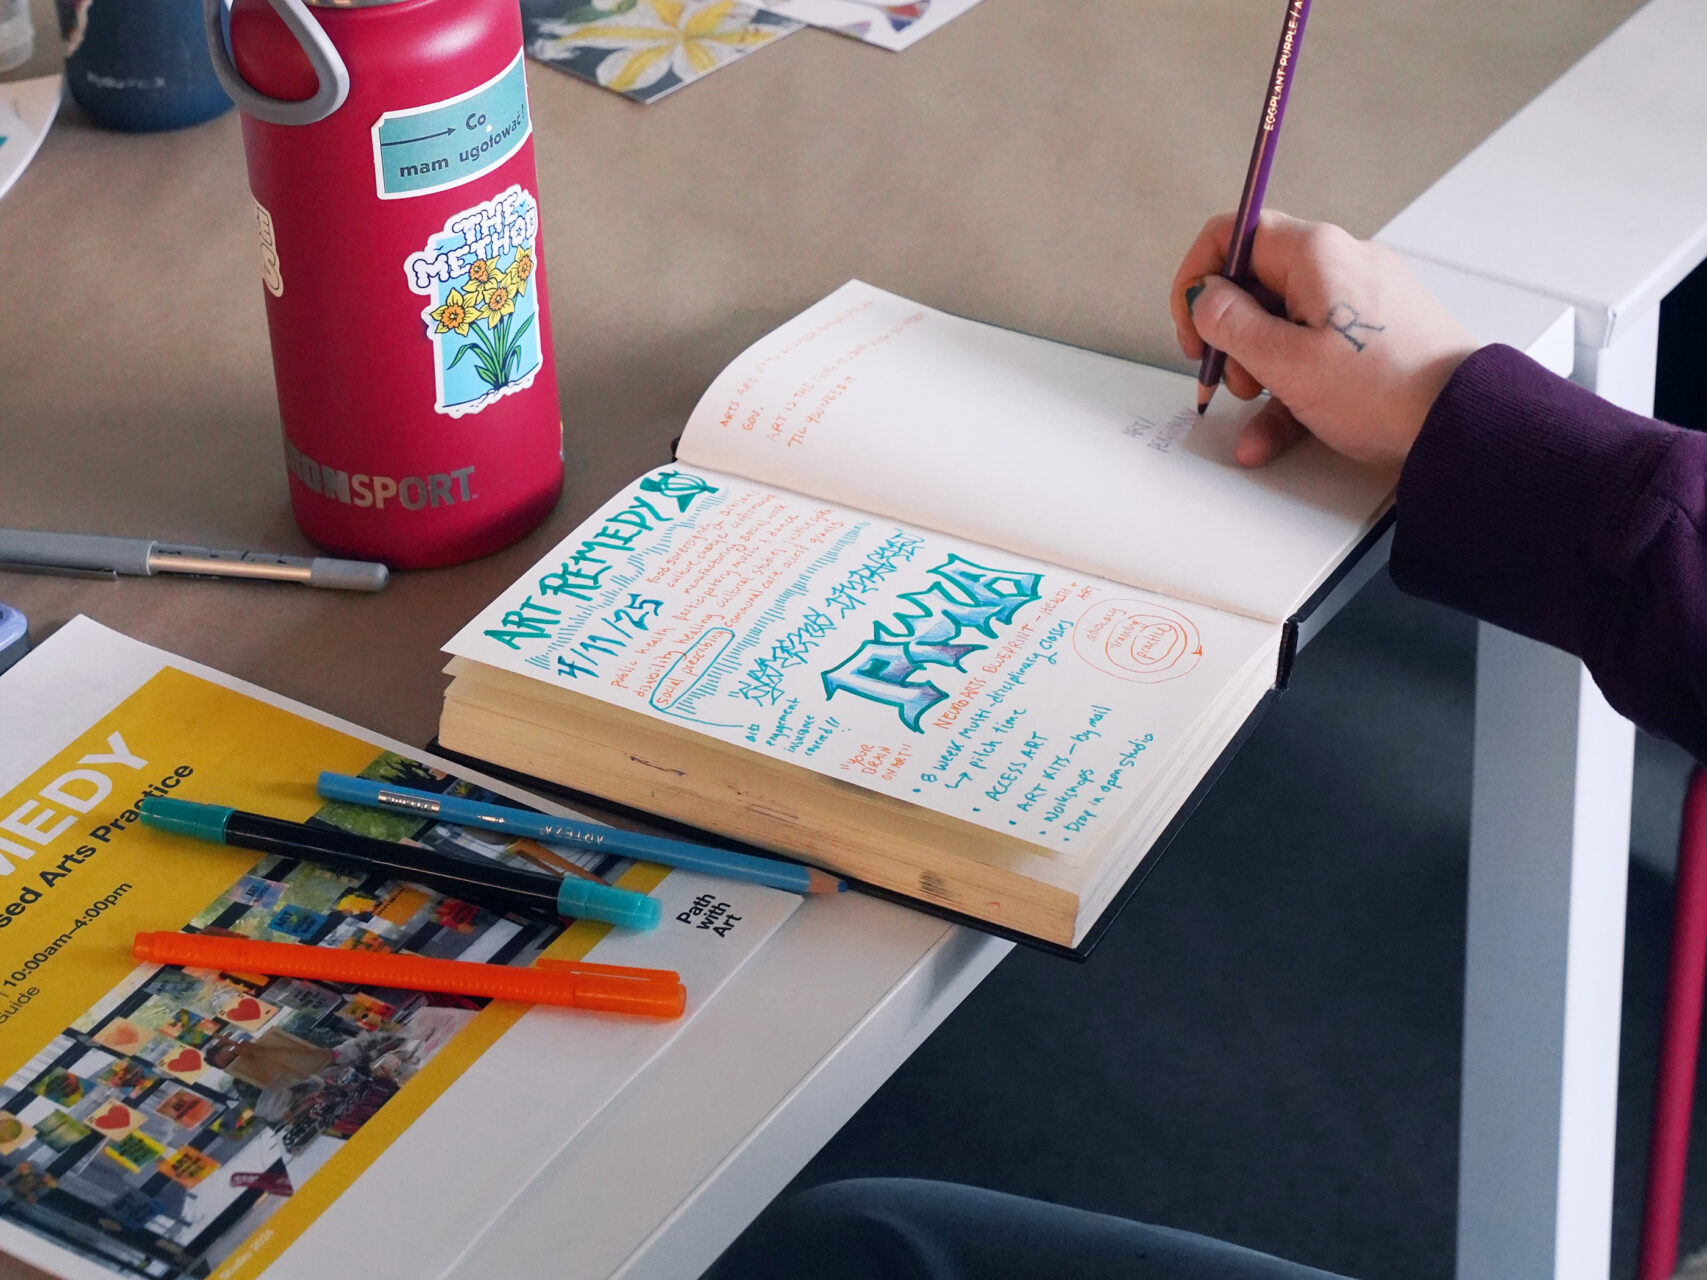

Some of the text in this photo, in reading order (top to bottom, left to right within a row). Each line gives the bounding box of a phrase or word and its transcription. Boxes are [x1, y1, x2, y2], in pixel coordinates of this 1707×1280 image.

[1263, 68, 1284, 131] EGGPLANT
[1279, 20, 1298, 67] PURPLE
[465, 112, 487, 131] Co
[399, 157, 449, 178] mam
[452, 192, 518, 240] THE
[412, 207, 535, 288] METHOD
[484, 496, 674, 650] ART REMEDY
[646, 566, 669, 584] food
[557, 593, 665, 679] 4/11/25
[673, 612, 726, 645] healing
[610, 658, 639, 689] public
[635, 627, 676, 655] health
[656, 677, 683, 706] social
[681, 630, 726, 676] prescribing
[765, 697, 800, 747] engagement
[787, 714, 816, 753] insurance
[969, 708, 1027, 770] pitch time
[935, 741, 965, 772] week
[984, 730, 1049, 802] ACCESS ART
[1016, 783, 1048, 813] ART
[1043, 754, 1071, 782] KITS
[1070, 726, 1101, 744] by
[1089, 704, 1113, 732] mail
[1091, 796, 1104, 807] in
[1118, 733, 1154, 769] studio
[39, 843, 97, 888] Arts
[89, 763, 195, 843] Practice
[676, 891, 717, 925] Path
[696, 900, 732, 932] with
[715, 913, 742, 938] Art
